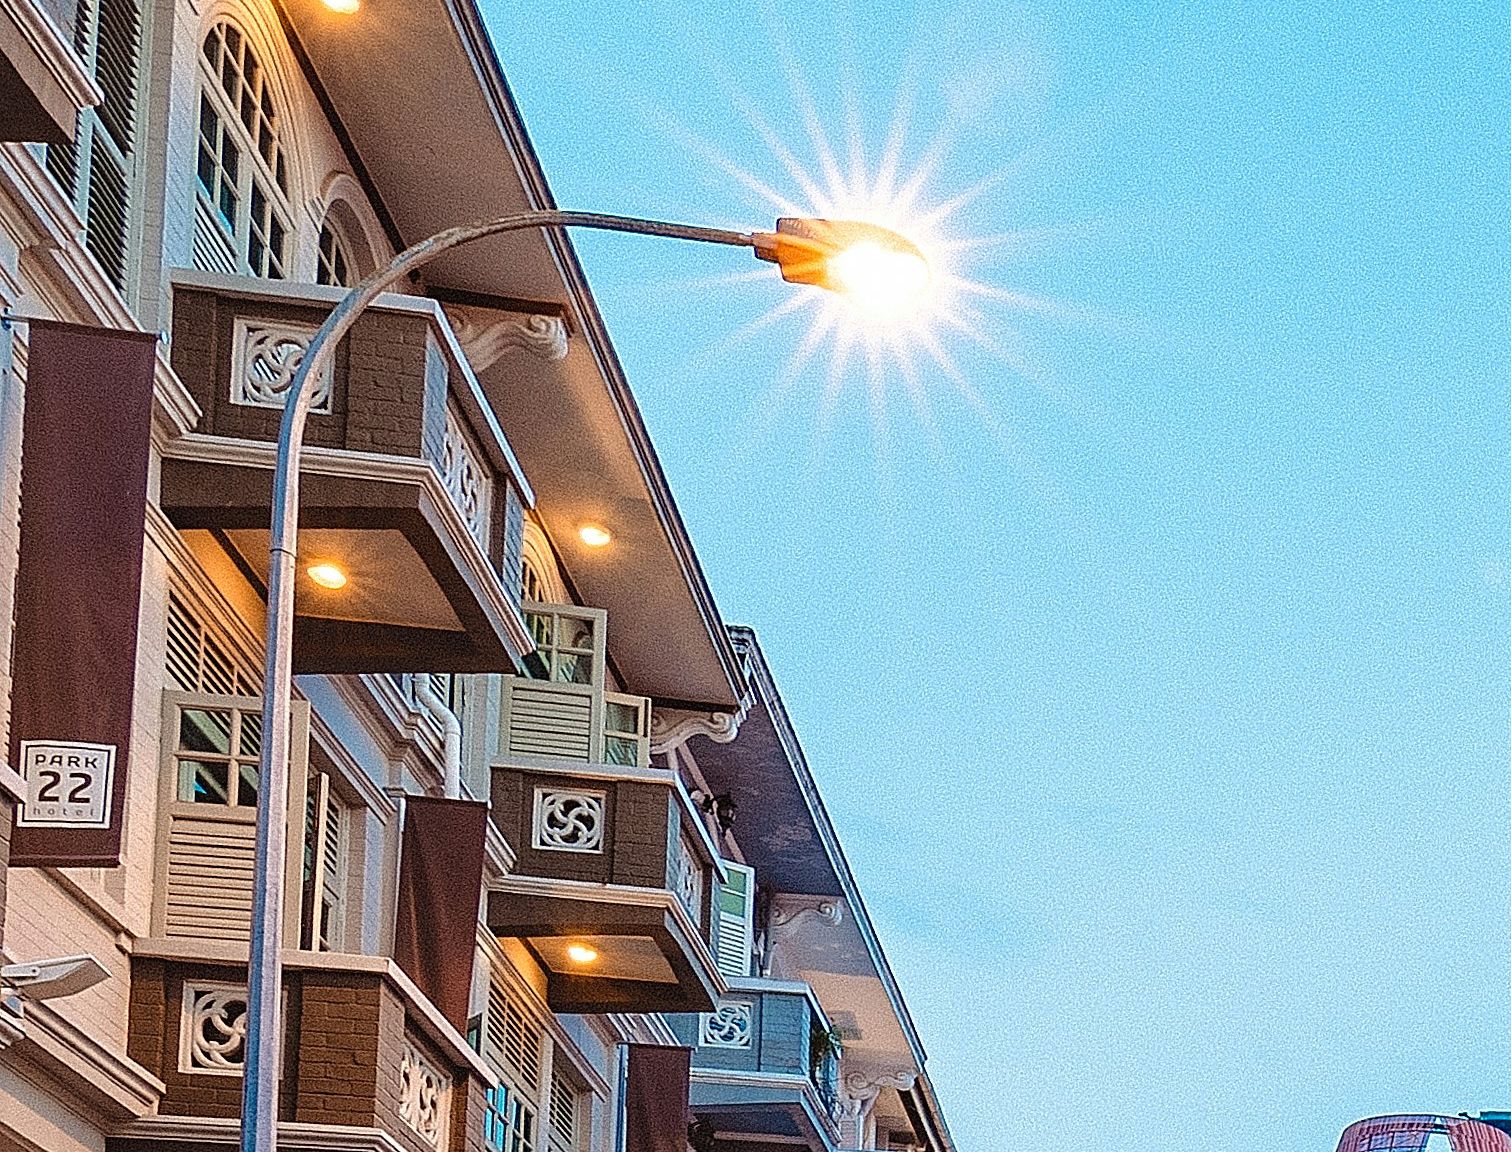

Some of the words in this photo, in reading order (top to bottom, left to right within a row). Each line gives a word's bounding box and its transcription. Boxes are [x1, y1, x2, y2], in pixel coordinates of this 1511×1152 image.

[34, 753, 98, 769] PARK
[38, 770, 93, 804] 22
[33, 807, 94, 816] hotel
